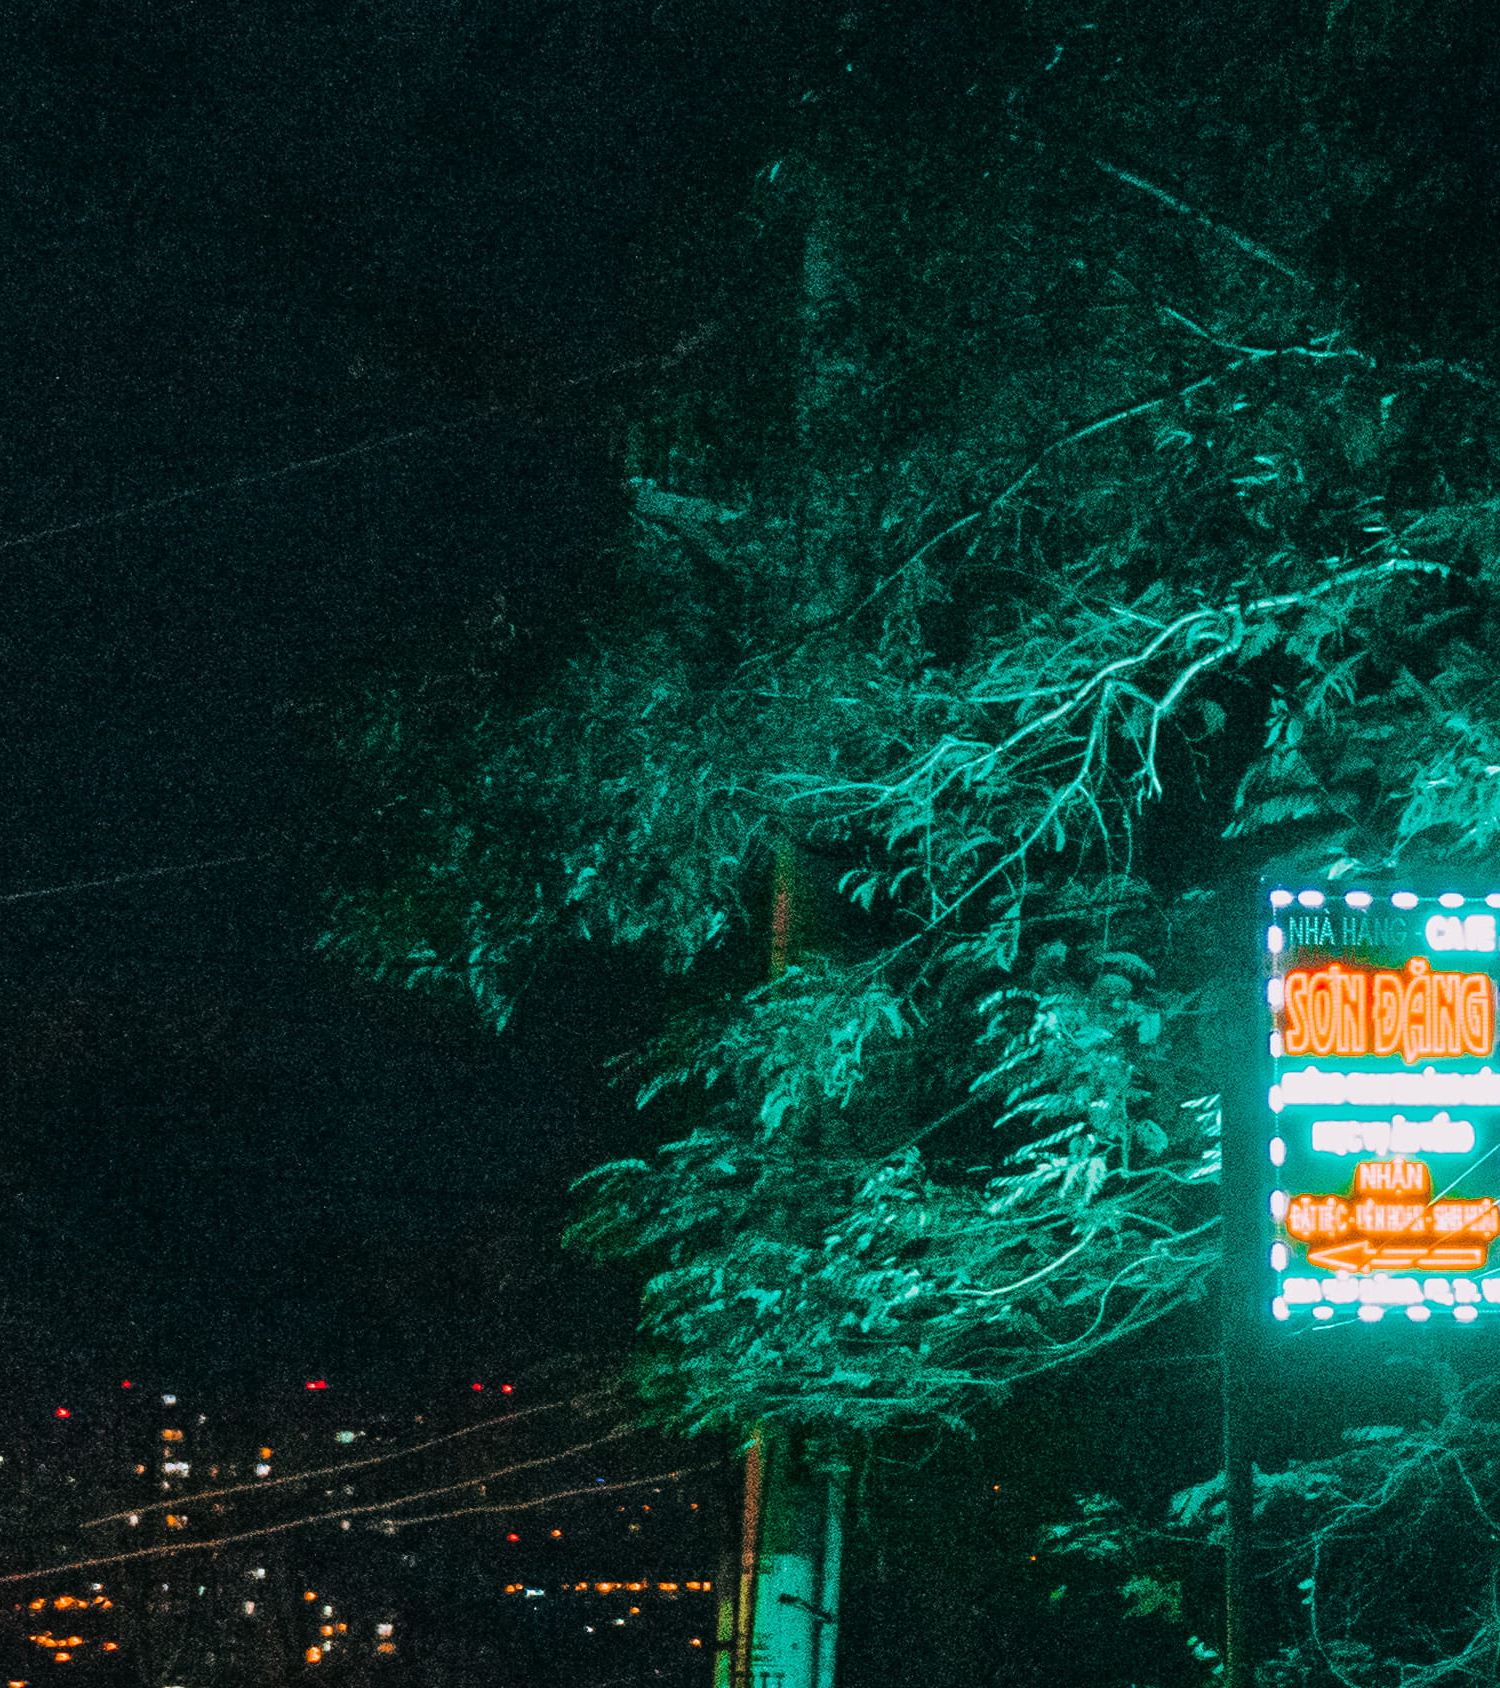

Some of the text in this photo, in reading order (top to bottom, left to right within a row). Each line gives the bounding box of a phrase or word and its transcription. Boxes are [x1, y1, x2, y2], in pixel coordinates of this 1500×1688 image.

[1288, 907, 1335, 946] NHÀ
[1285, 965, 1366, 1054] SƠN
[1358, 1157, 1424, 1195] NHẬN
